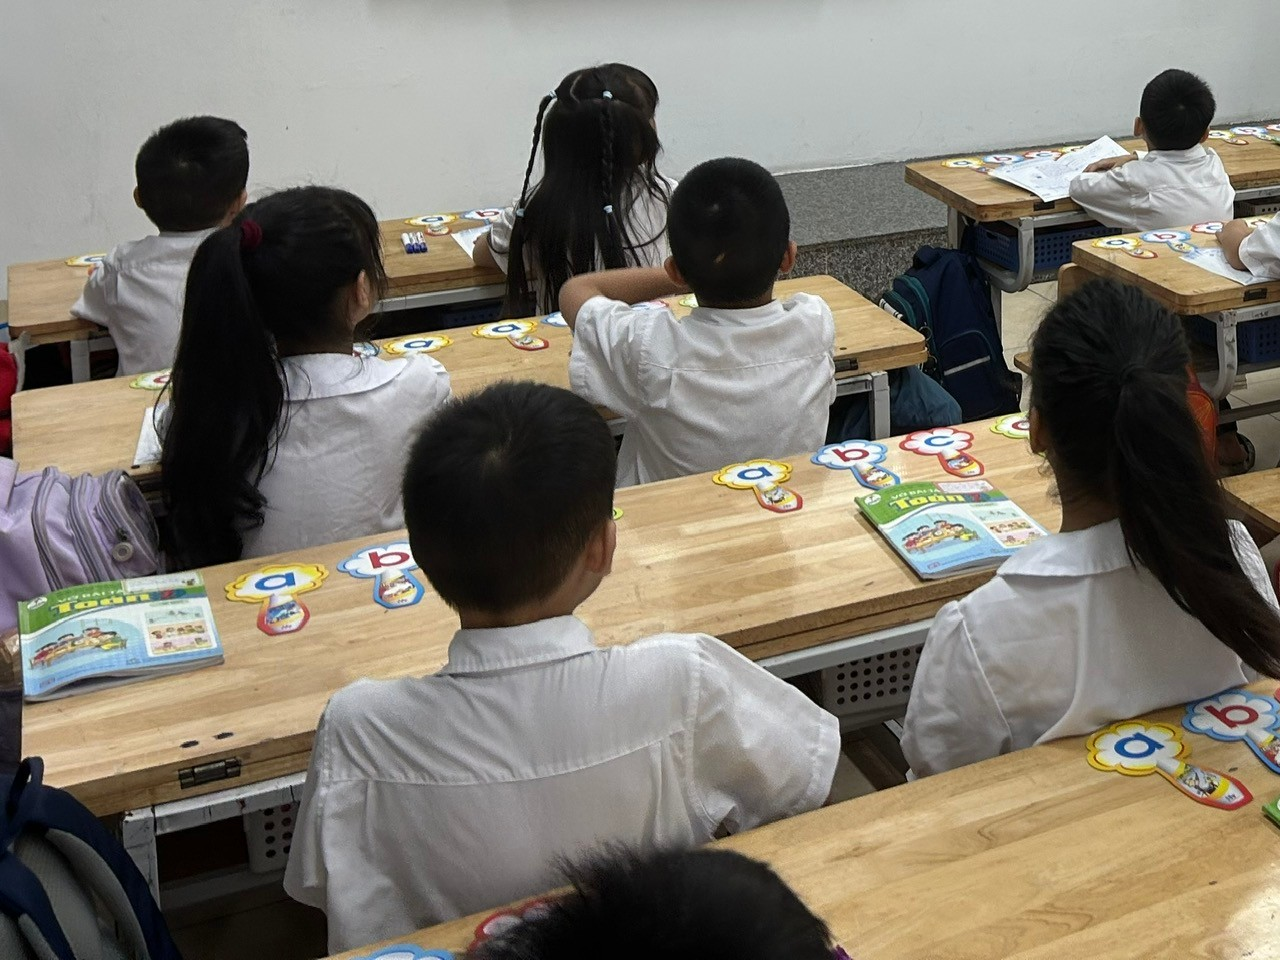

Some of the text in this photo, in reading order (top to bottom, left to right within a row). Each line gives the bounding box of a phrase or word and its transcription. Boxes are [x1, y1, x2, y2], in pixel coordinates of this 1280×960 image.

[421, 215, 444, 224] a
[474, 209, 500, 218] b
[491, 323, 520, 333] a
[403, 338, 434, 349] a
[923, 435, 954, 447] c
[832, 447, 870, 463] b
[737, 466, 773, 481] a
[889, 493, 966, 511] Toán
[368, 551, 411, 569] b
[254, 571, 297, 592] a
[1204, 704, 1260, 730] b
[1113, 731, 1165, 759] a
